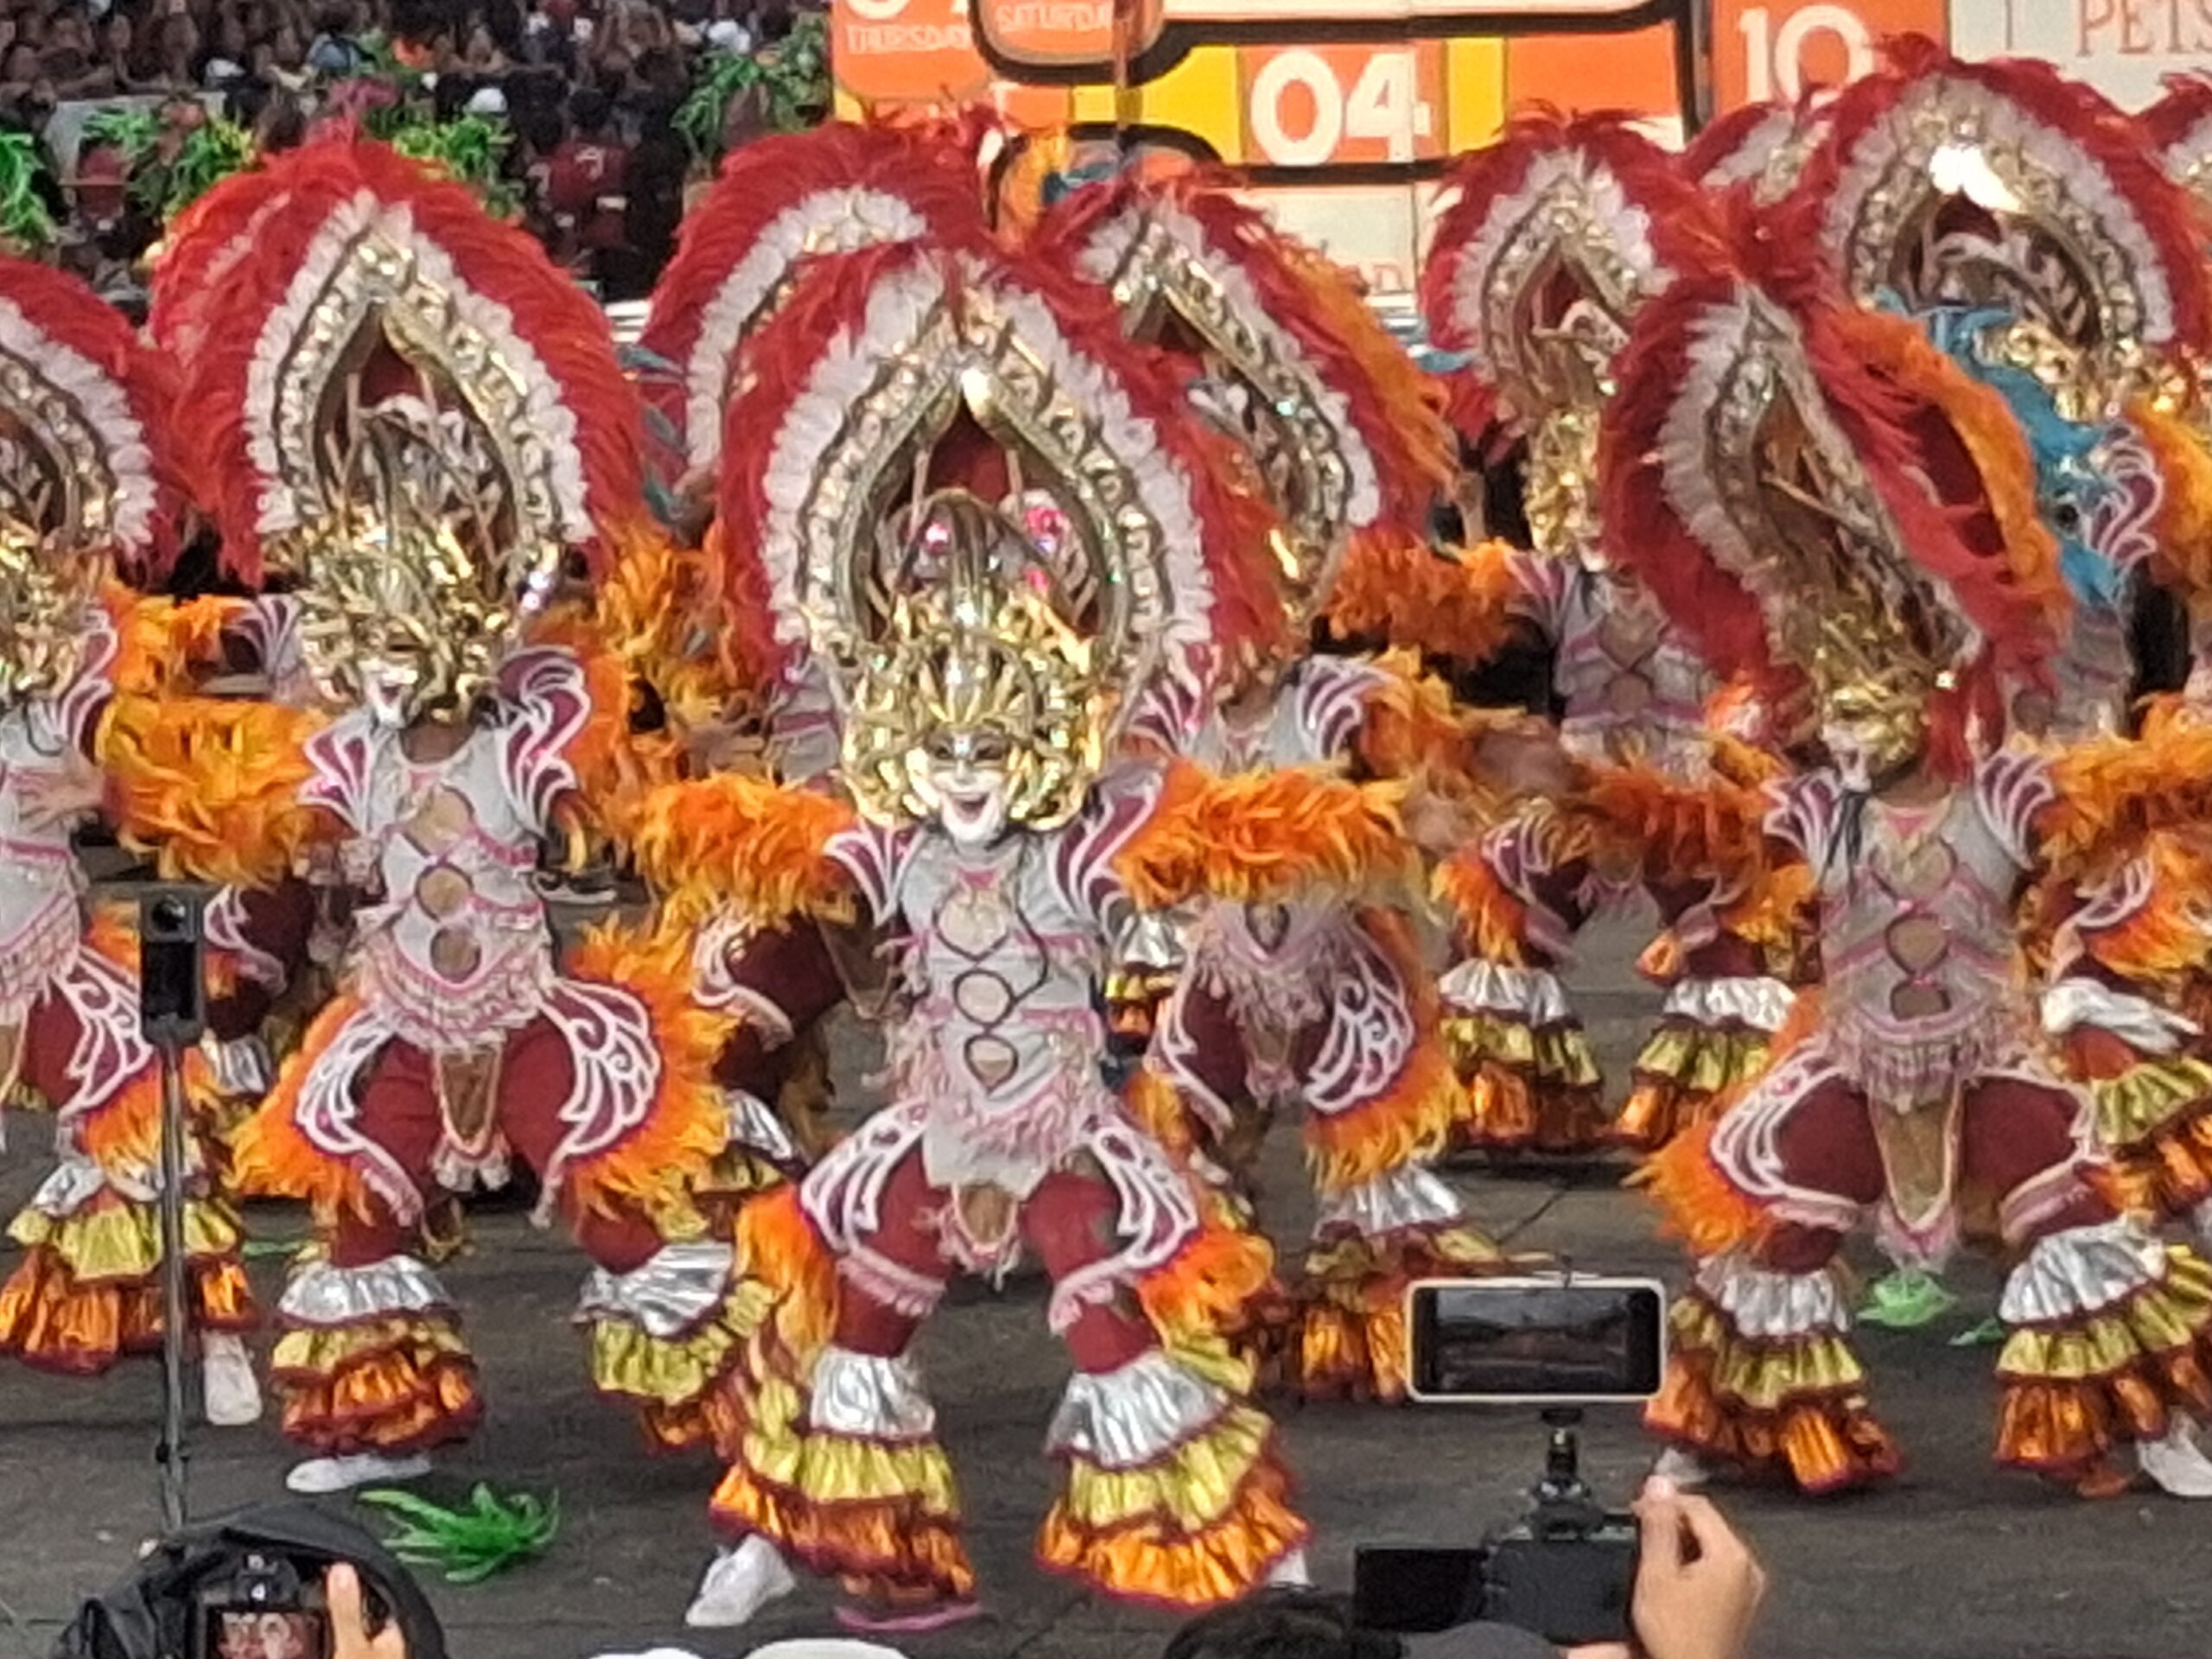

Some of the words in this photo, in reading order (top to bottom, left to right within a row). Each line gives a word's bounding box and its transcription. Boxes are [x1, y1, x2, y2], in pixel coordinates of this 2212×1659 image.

[995, 2, 1114, 33] SATURDA
[1739, 4, 1874, 109] 10
[1250, 50, 1431, 165] 04
